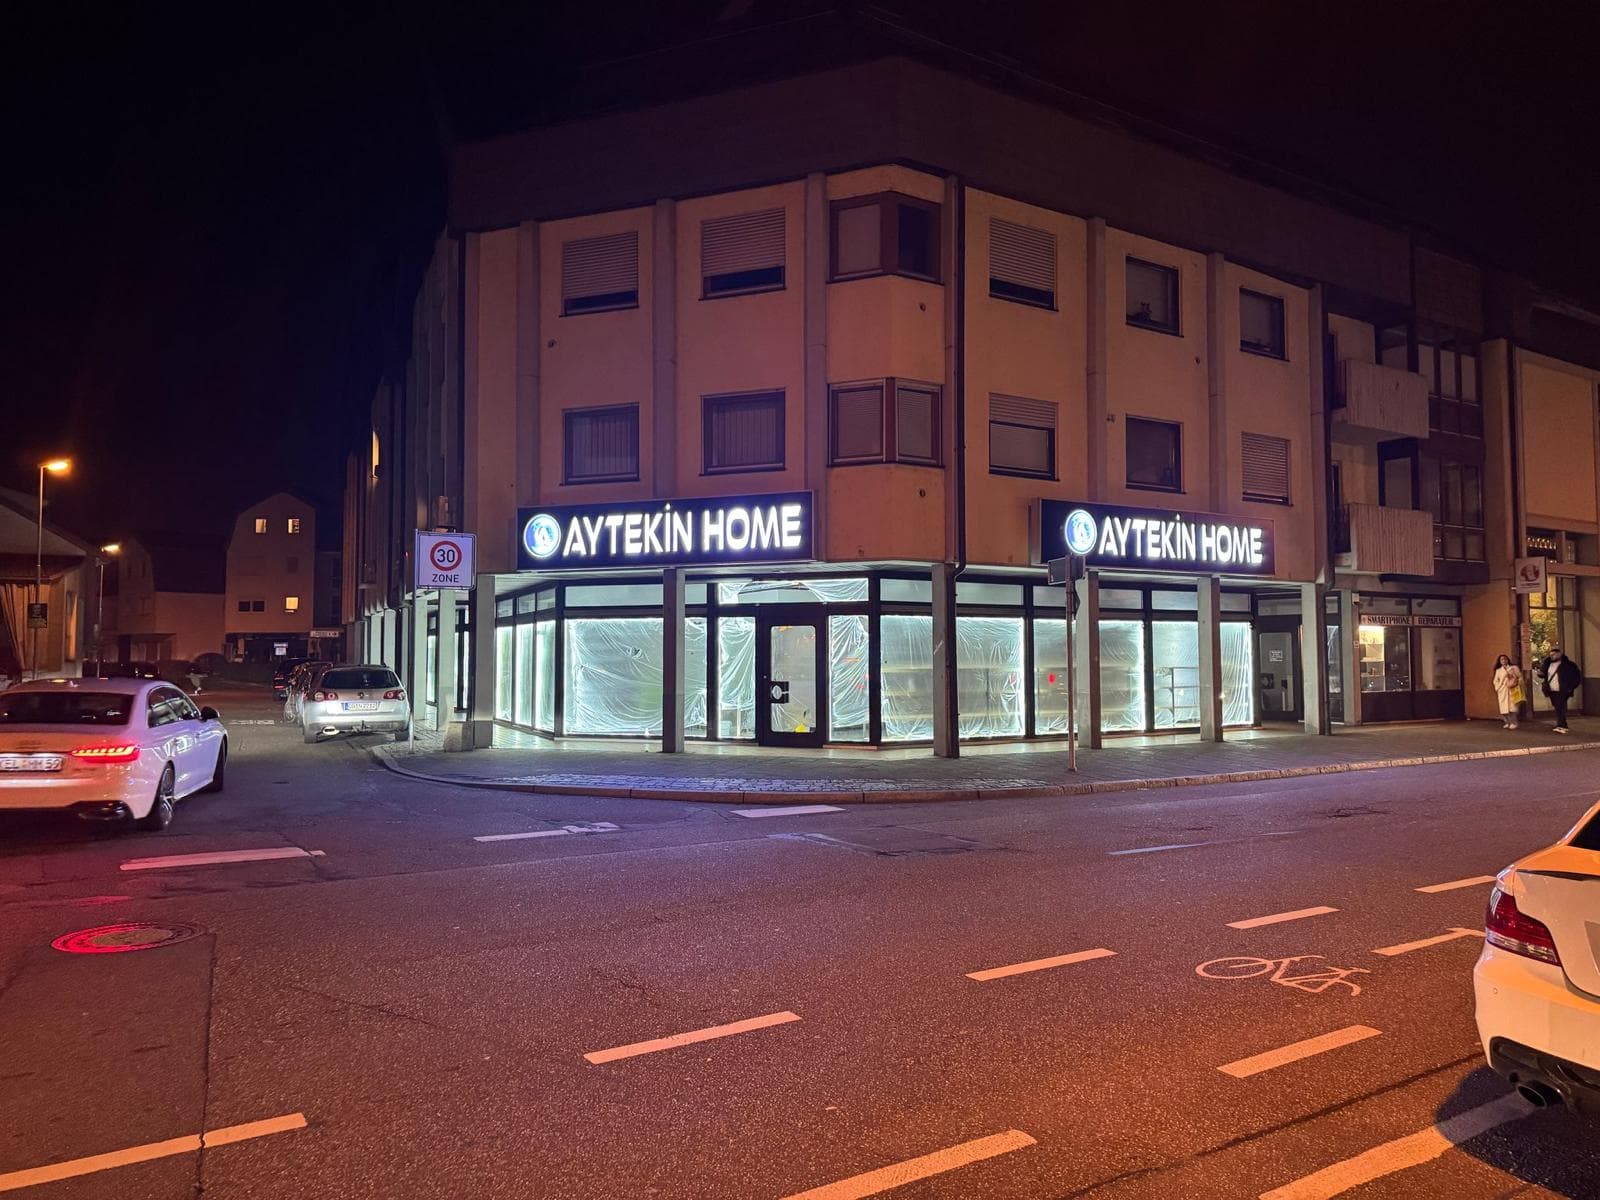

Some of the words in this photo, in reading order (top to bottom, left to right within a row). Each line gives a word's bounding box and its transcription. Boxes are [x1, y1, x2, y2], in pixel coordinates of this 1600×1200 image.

[563, 503, 693, 556] AYTEKİN
[703, 504, 803, 552] HOME
[1098, 513, 1196, 561] AYTEKİN
[1201, 523, 1264, 565] HOME
[436, 548, 456, 563] 30
[431, 573, 460, 583] ZONE
[1367, 615, 1410, 625] SMARTPHONE
